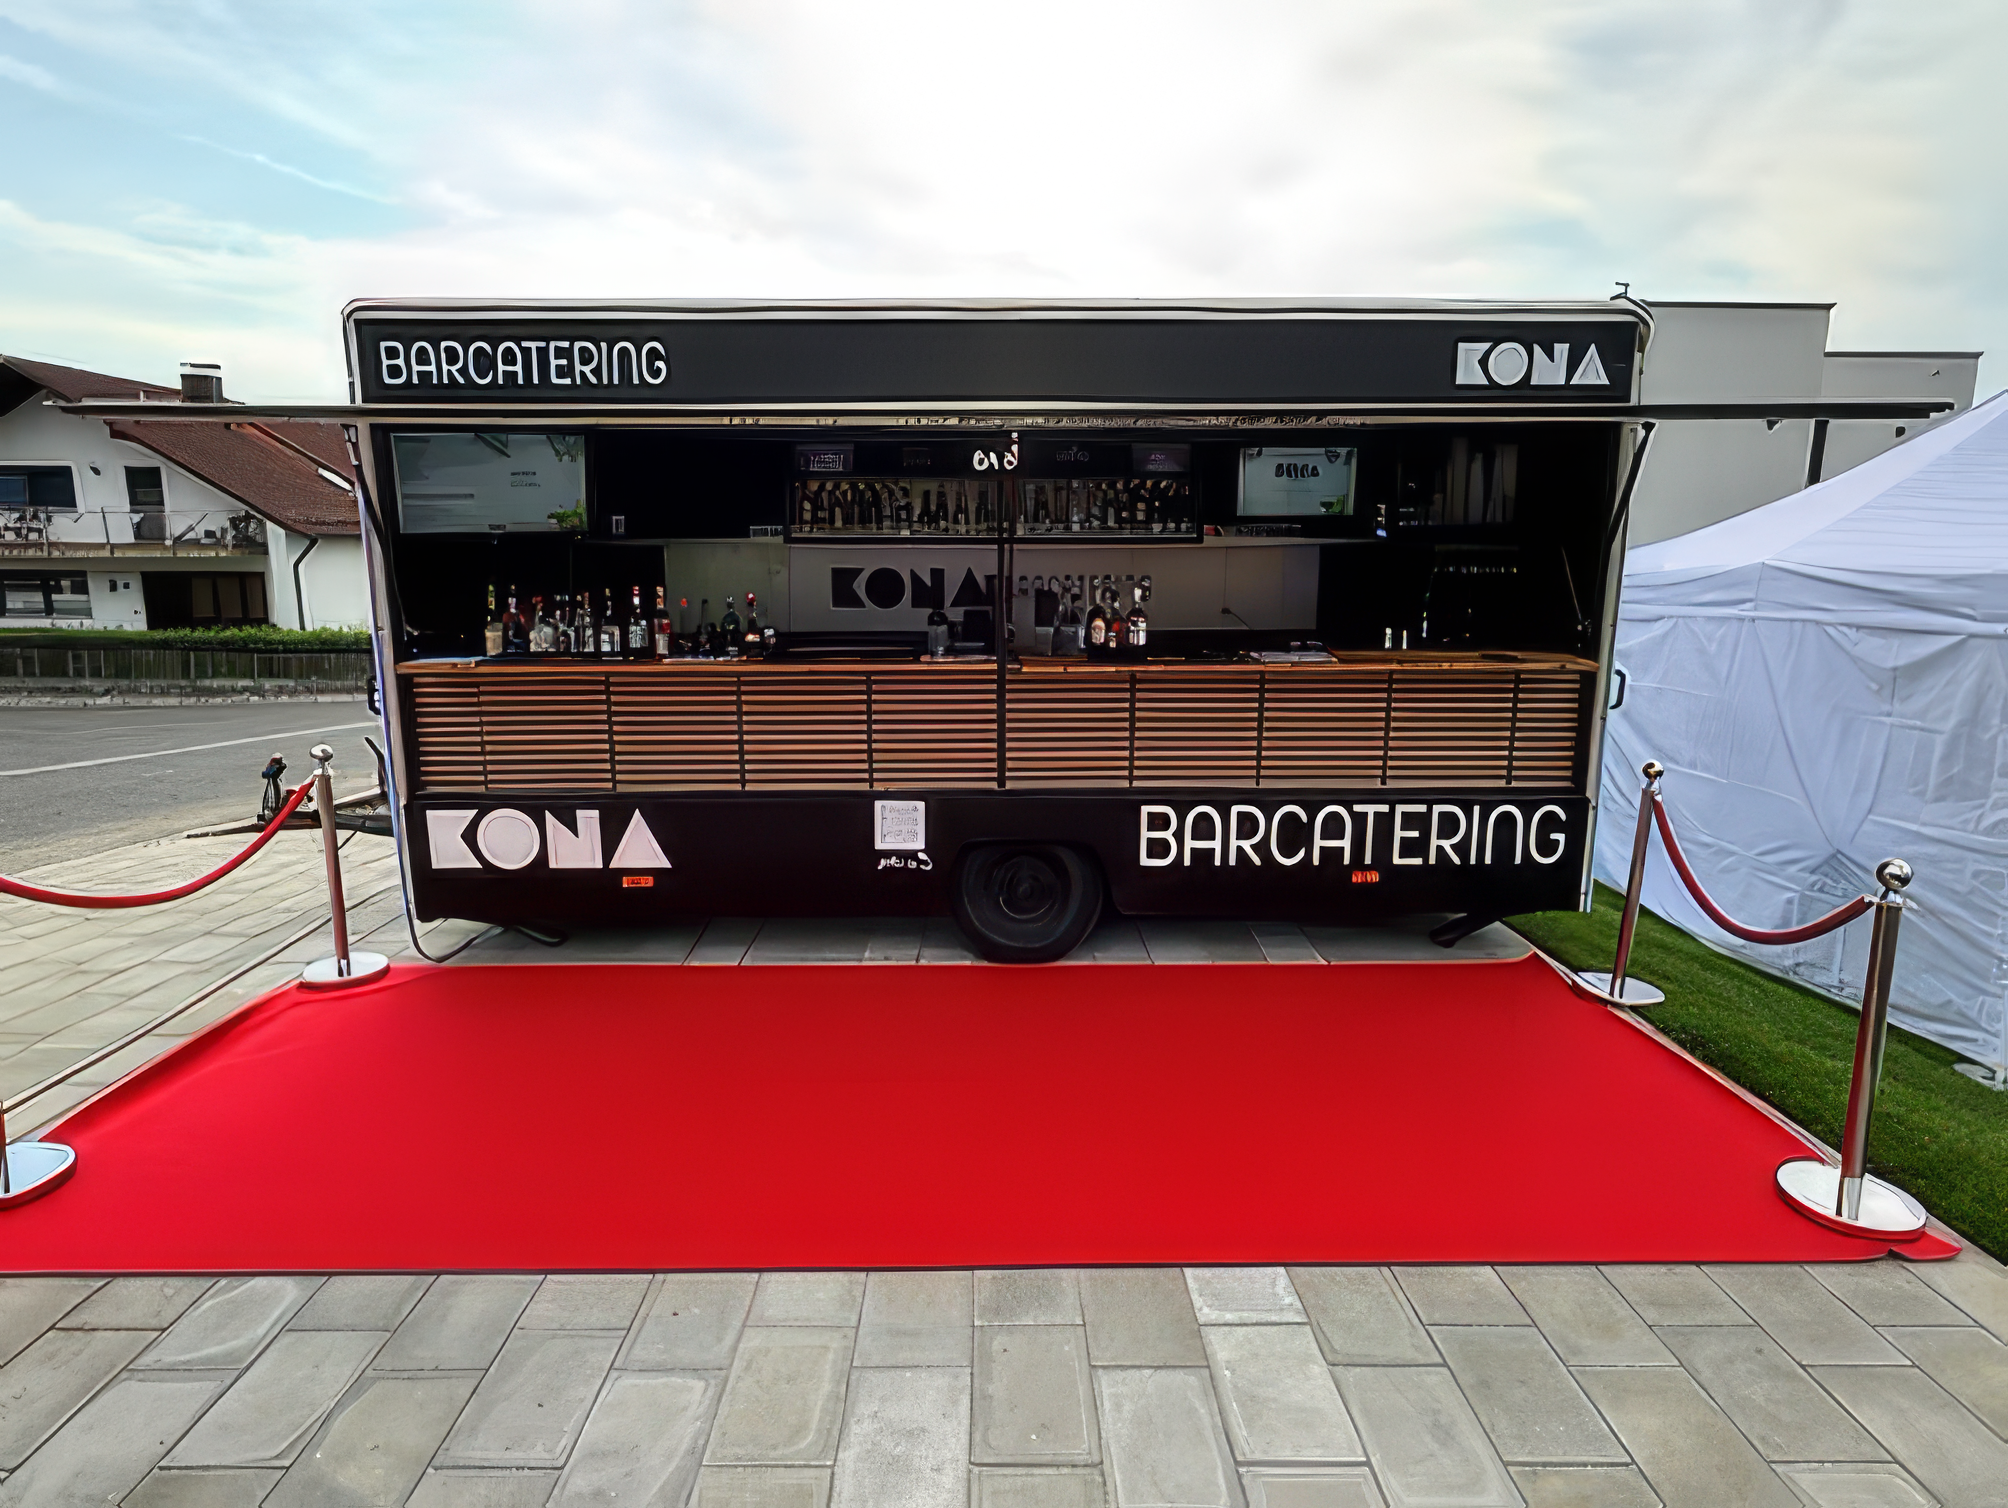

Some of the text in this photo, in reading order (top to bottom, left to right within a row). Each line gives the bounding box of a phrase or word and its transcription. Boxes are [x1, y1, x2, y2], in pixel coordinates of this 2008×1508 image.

[379, 339, 668, 386] BARCATERING
[1455, 341, 1610, 386] KONA
[830, 566, 987, 610] KONA
[425, 808, 672, 870] KONA
[1138, 803, 1568, 868] BARCATERING
